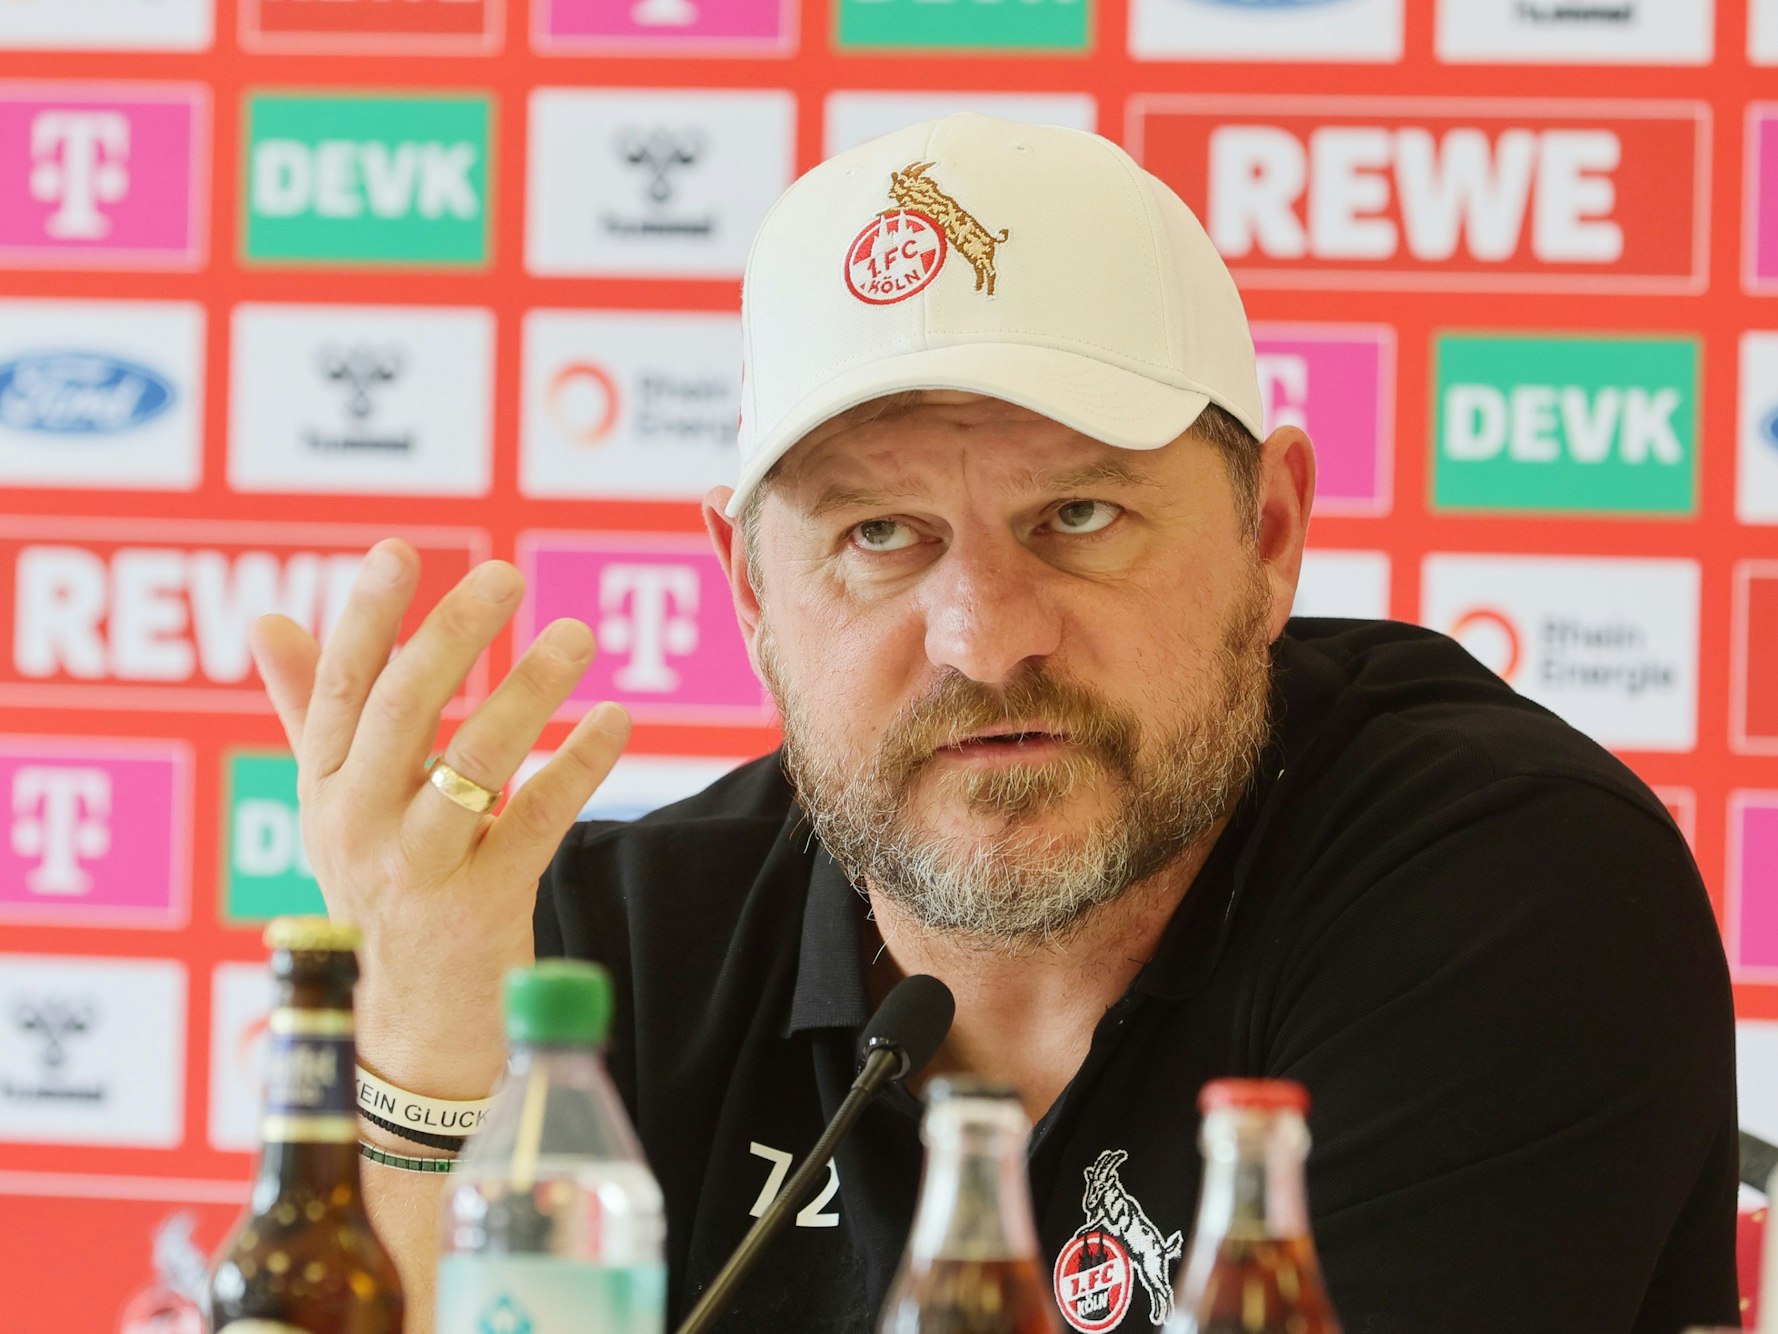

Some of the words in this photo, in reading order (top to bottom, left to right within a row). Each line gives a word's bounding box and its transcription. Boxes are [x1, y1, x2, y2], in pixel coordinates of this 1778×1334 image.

[253, 138, 481, 221] DEVK
[1207, 124, 1624, 265] REWE
[1442, 383, 1684, 466] DEVK
[12, 545, 372, 683] REW
[355, 1079, 396, 1114] EIN
[404, 1104, 490, 1128] GLUCK
